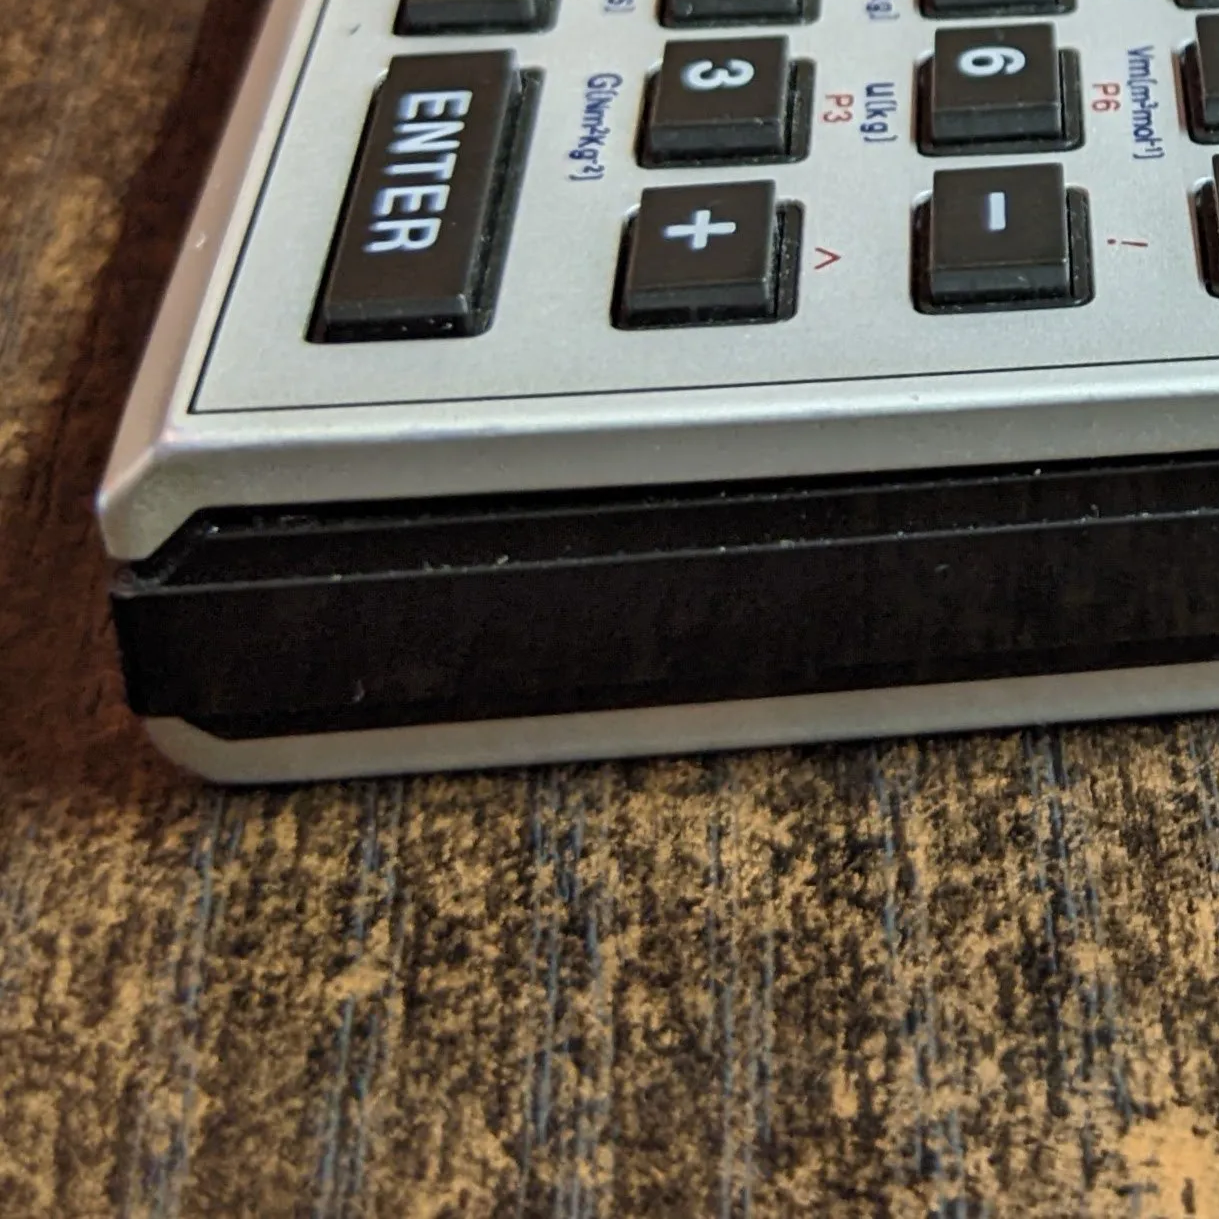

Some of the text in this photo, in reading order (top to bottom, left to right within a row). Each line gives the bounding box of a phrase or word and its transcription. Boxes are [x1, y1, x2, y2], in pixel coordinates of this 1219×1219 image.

[684, 59, 756, 92] 3
[956, 44, 1027, 76] 6
[821, 92, 854, 124] P3
[861, 80, 898, 145] u(kg)
[1091, 82, 1122, 113] P6
[362, 88, 473, 253] ENTER
[662, 208, 737, 251] +
